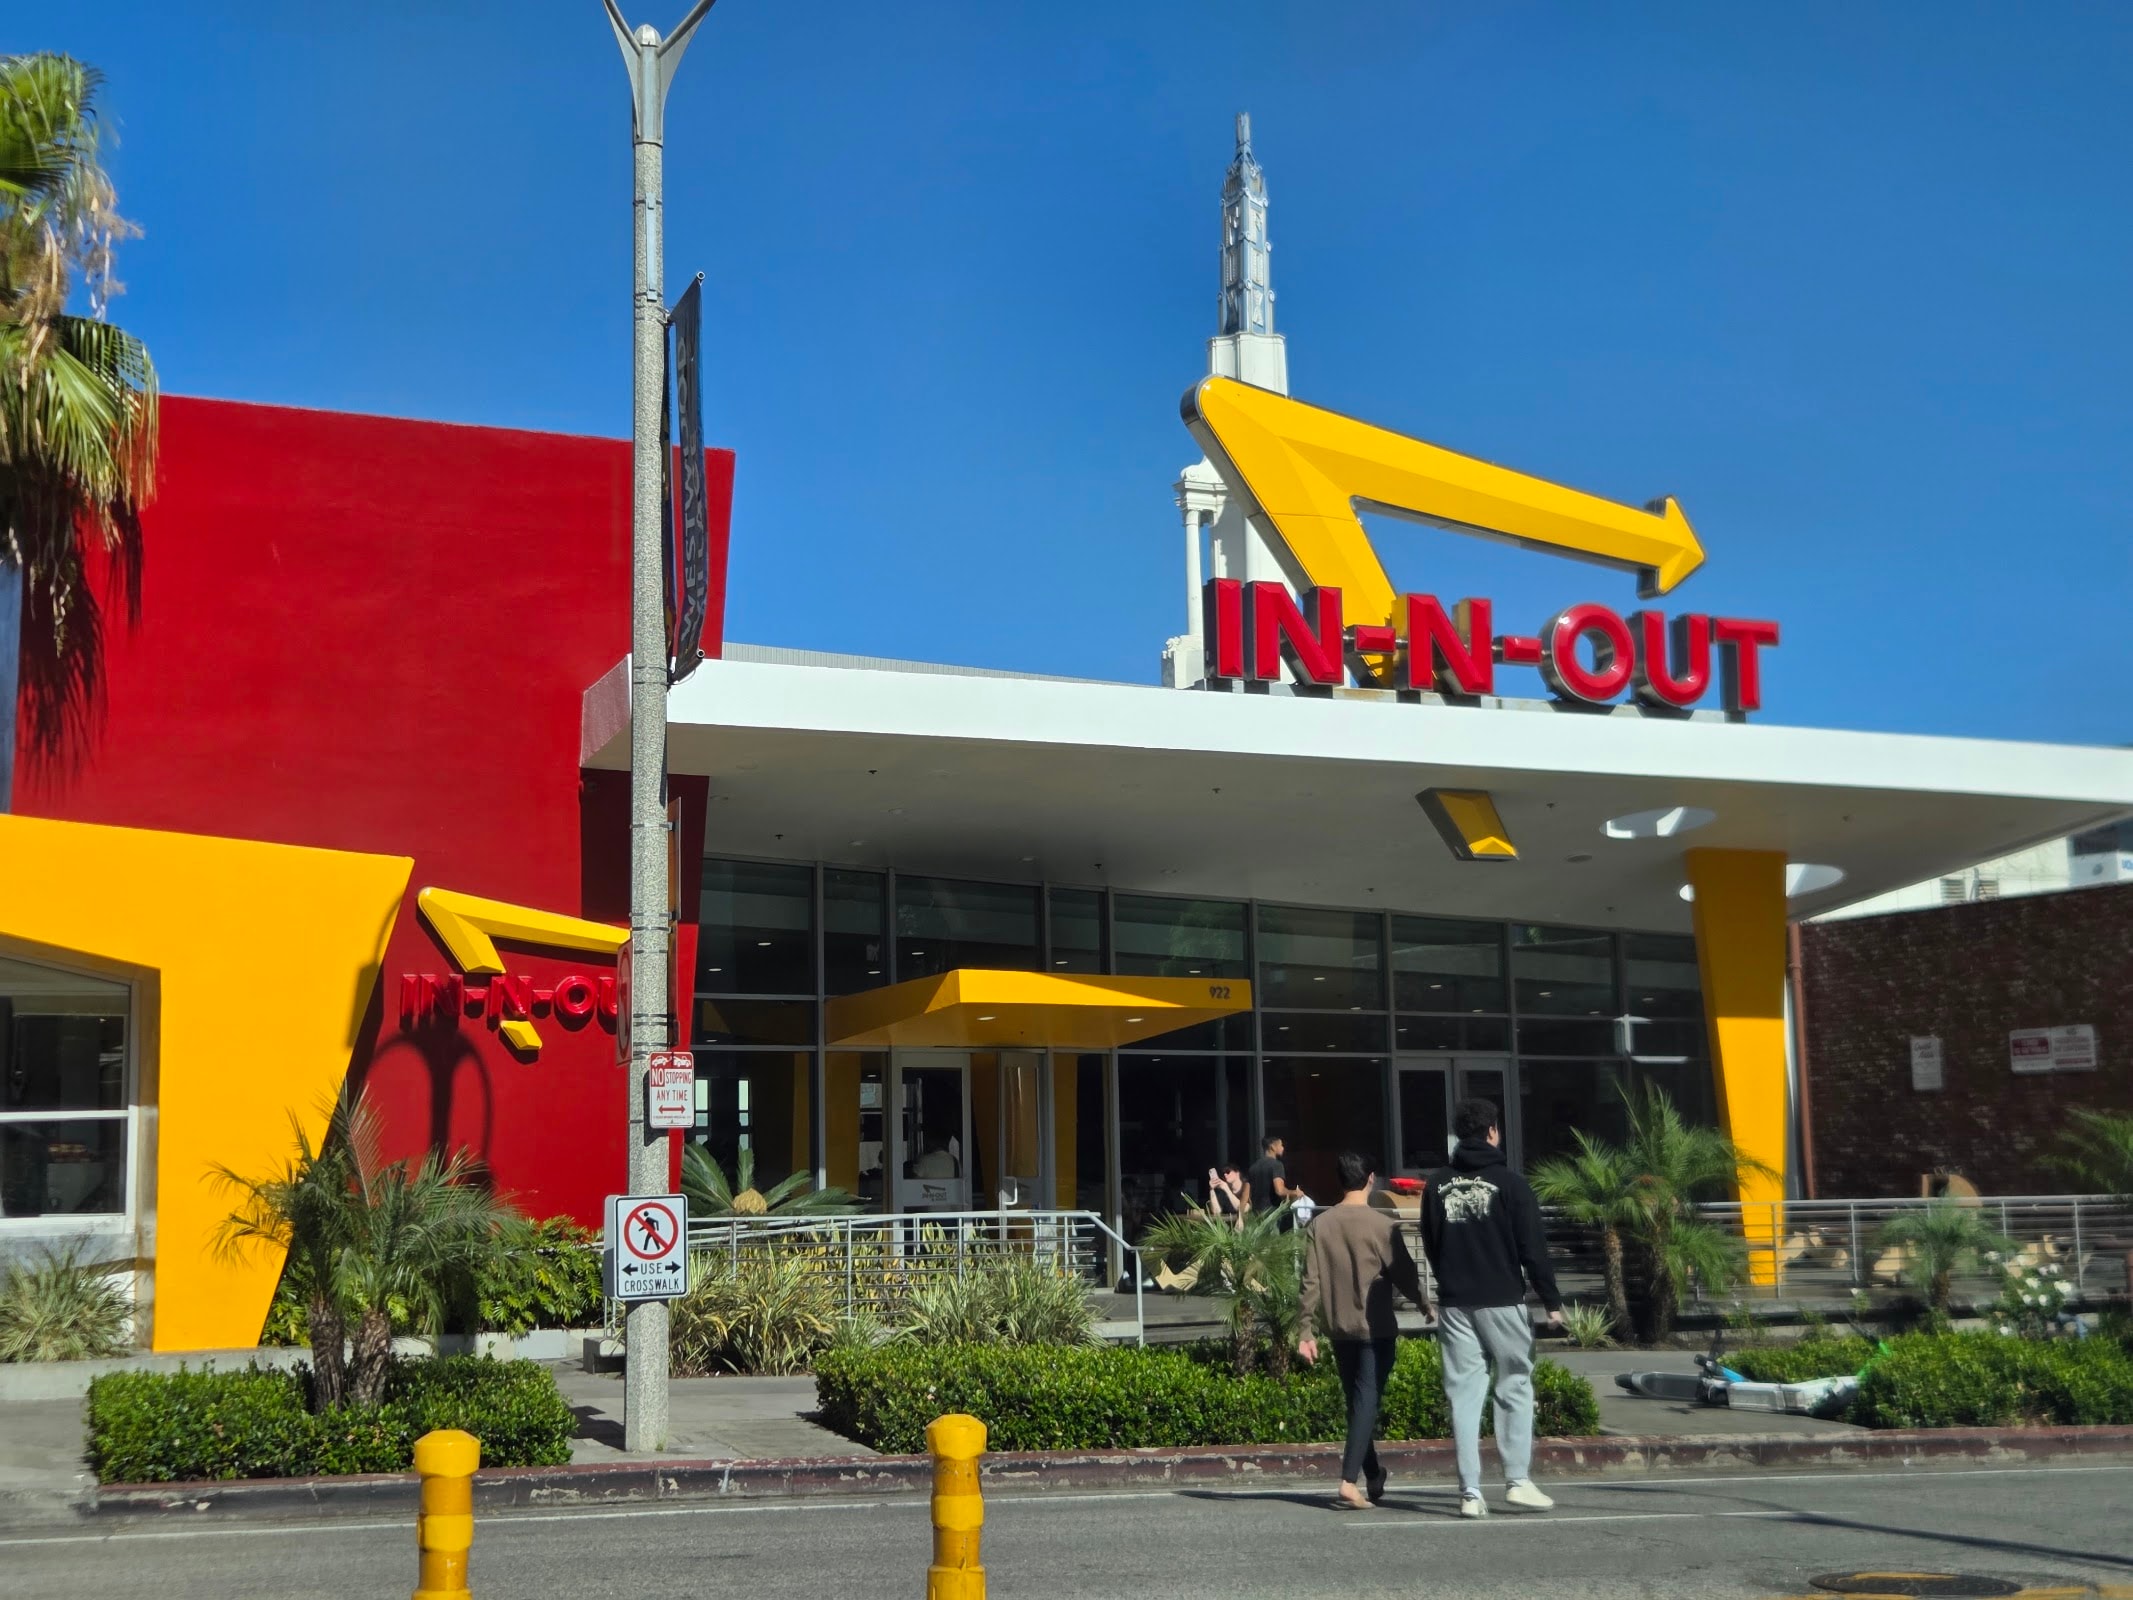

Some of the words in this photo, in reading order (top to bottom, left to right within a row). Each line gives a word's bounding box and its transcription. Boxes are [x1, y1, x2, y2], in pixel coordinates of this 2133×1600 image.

[677, 336, 697, 642] WESTWOOD
[1206, 576, 1780, 712] IN-N-OUT
[1209, 985, 1231, 999] 922
[651, 1068, 665, 1085] NO
[665, 1071, 692, 1084] STOPPING
[656, 1089, 671, 1102] ANY
[672, 1089, 688, 1102] TIME
[640, 1262, 663, 1275] USE
[624, 1278, 680, 1293] CROSSWALK
